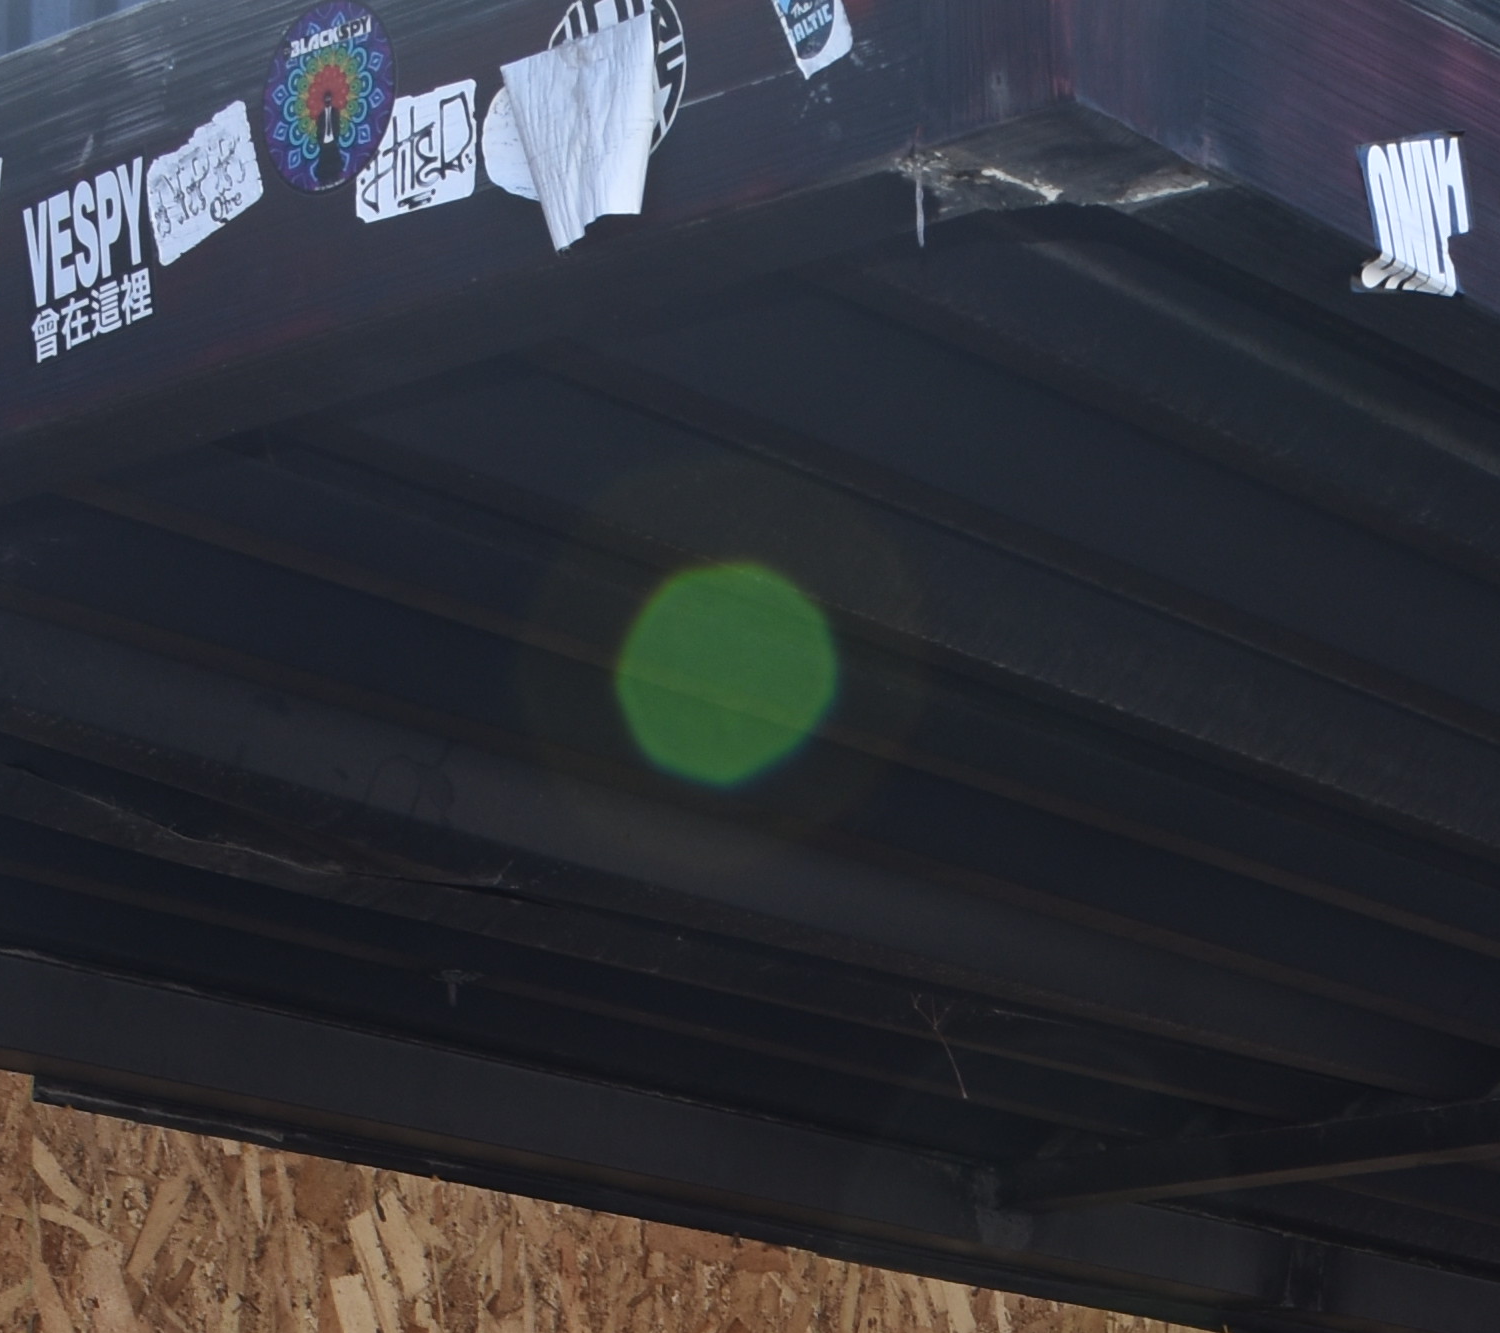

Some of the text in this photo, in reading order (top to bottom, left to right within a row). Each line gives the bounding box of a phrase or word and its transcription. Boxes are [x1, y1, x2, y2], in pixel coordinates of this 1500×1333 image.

[23, 156, 143, 308] VESPY
[31, 268, 153, 363] 曾在這裡
